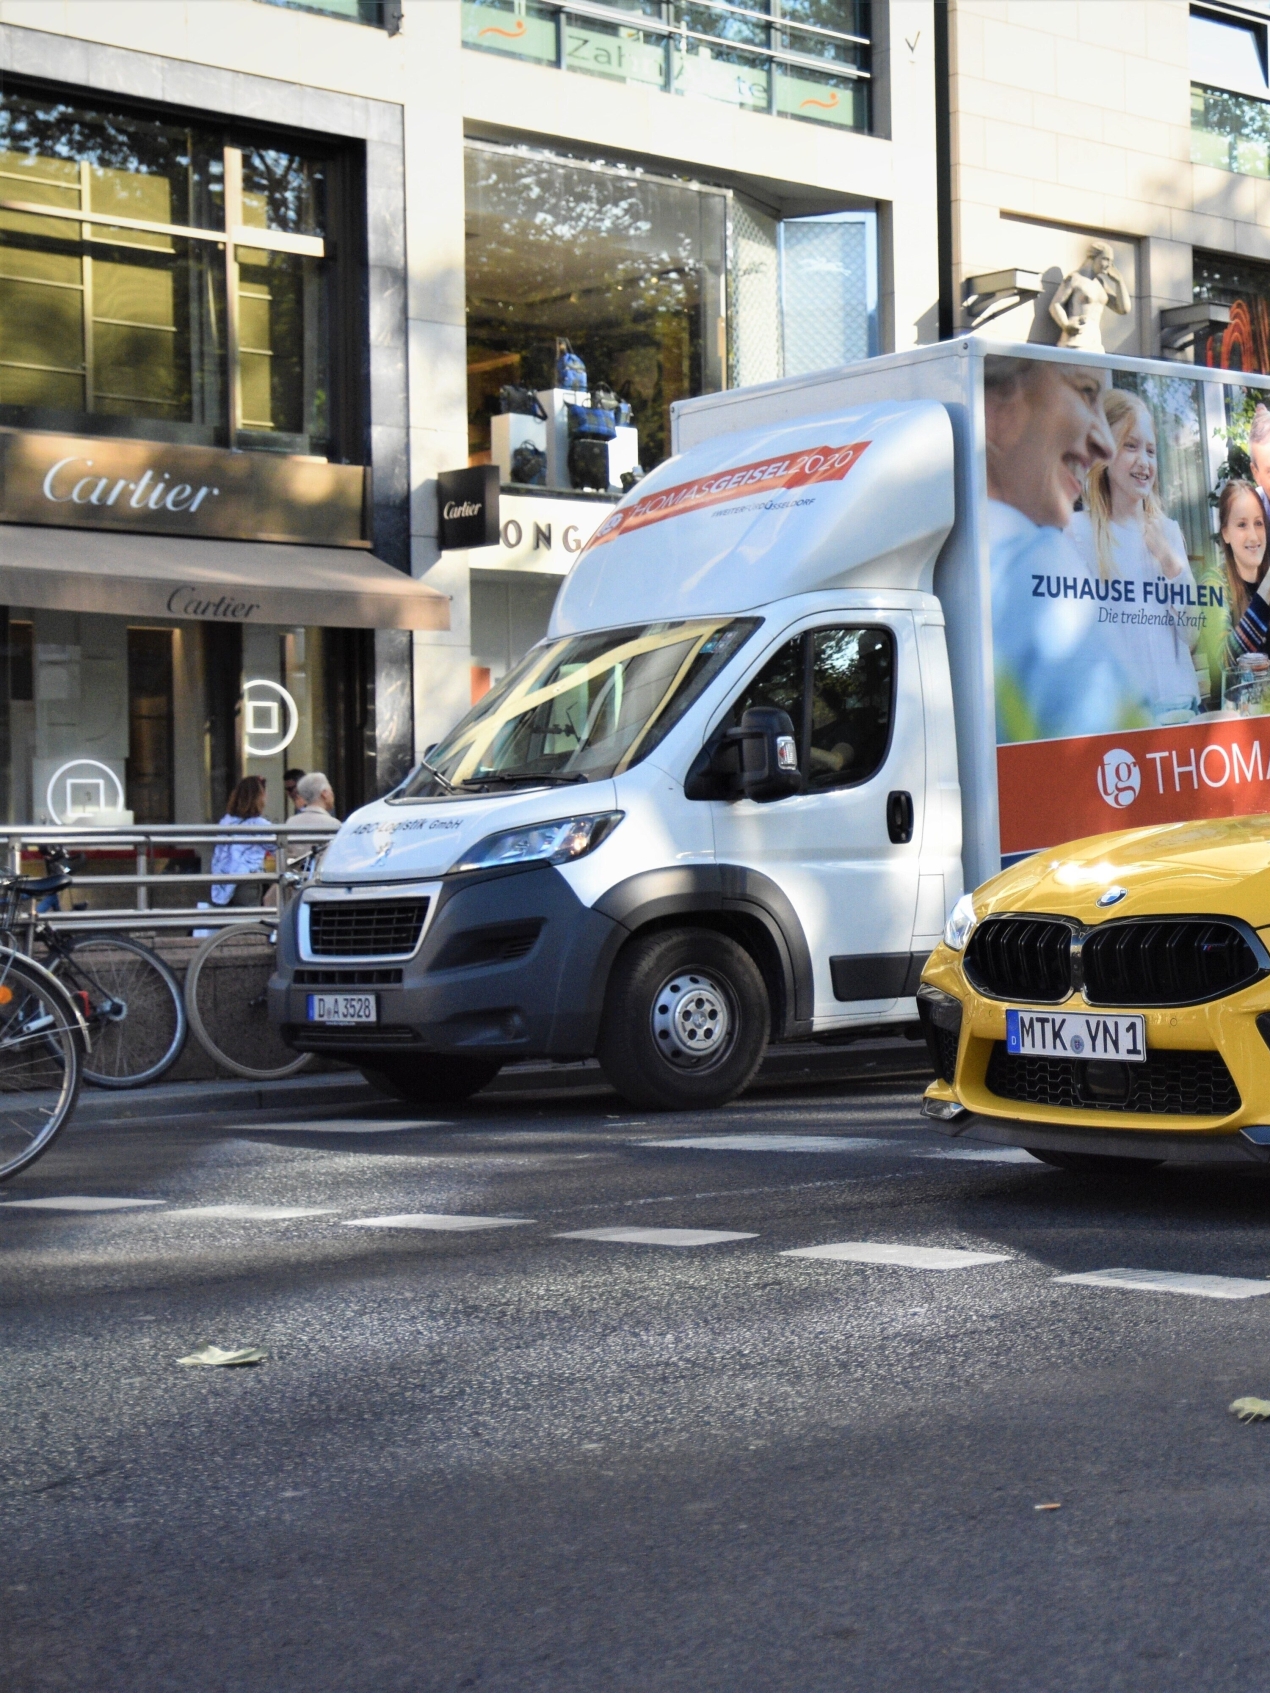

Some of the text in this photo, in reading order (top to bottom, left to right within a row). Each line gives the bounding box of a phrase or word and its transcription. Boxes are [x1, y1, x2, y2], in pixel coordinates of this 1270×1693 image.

[43, 456, 219, 512] Cartier
[443, 501, 482, 520] Cartier
[166, 585, 260, 618] Cartier
[1031, 574, 1224, 608] ZUHAUSE FÜHLEN
[1097, 607, 1208, 631] Die treibende Kraft
[428, 819, 464, 831] GmbH
[318, 998, 371, 1018] D A 3528
[1019, 1016, 1068, 1051] MTK
